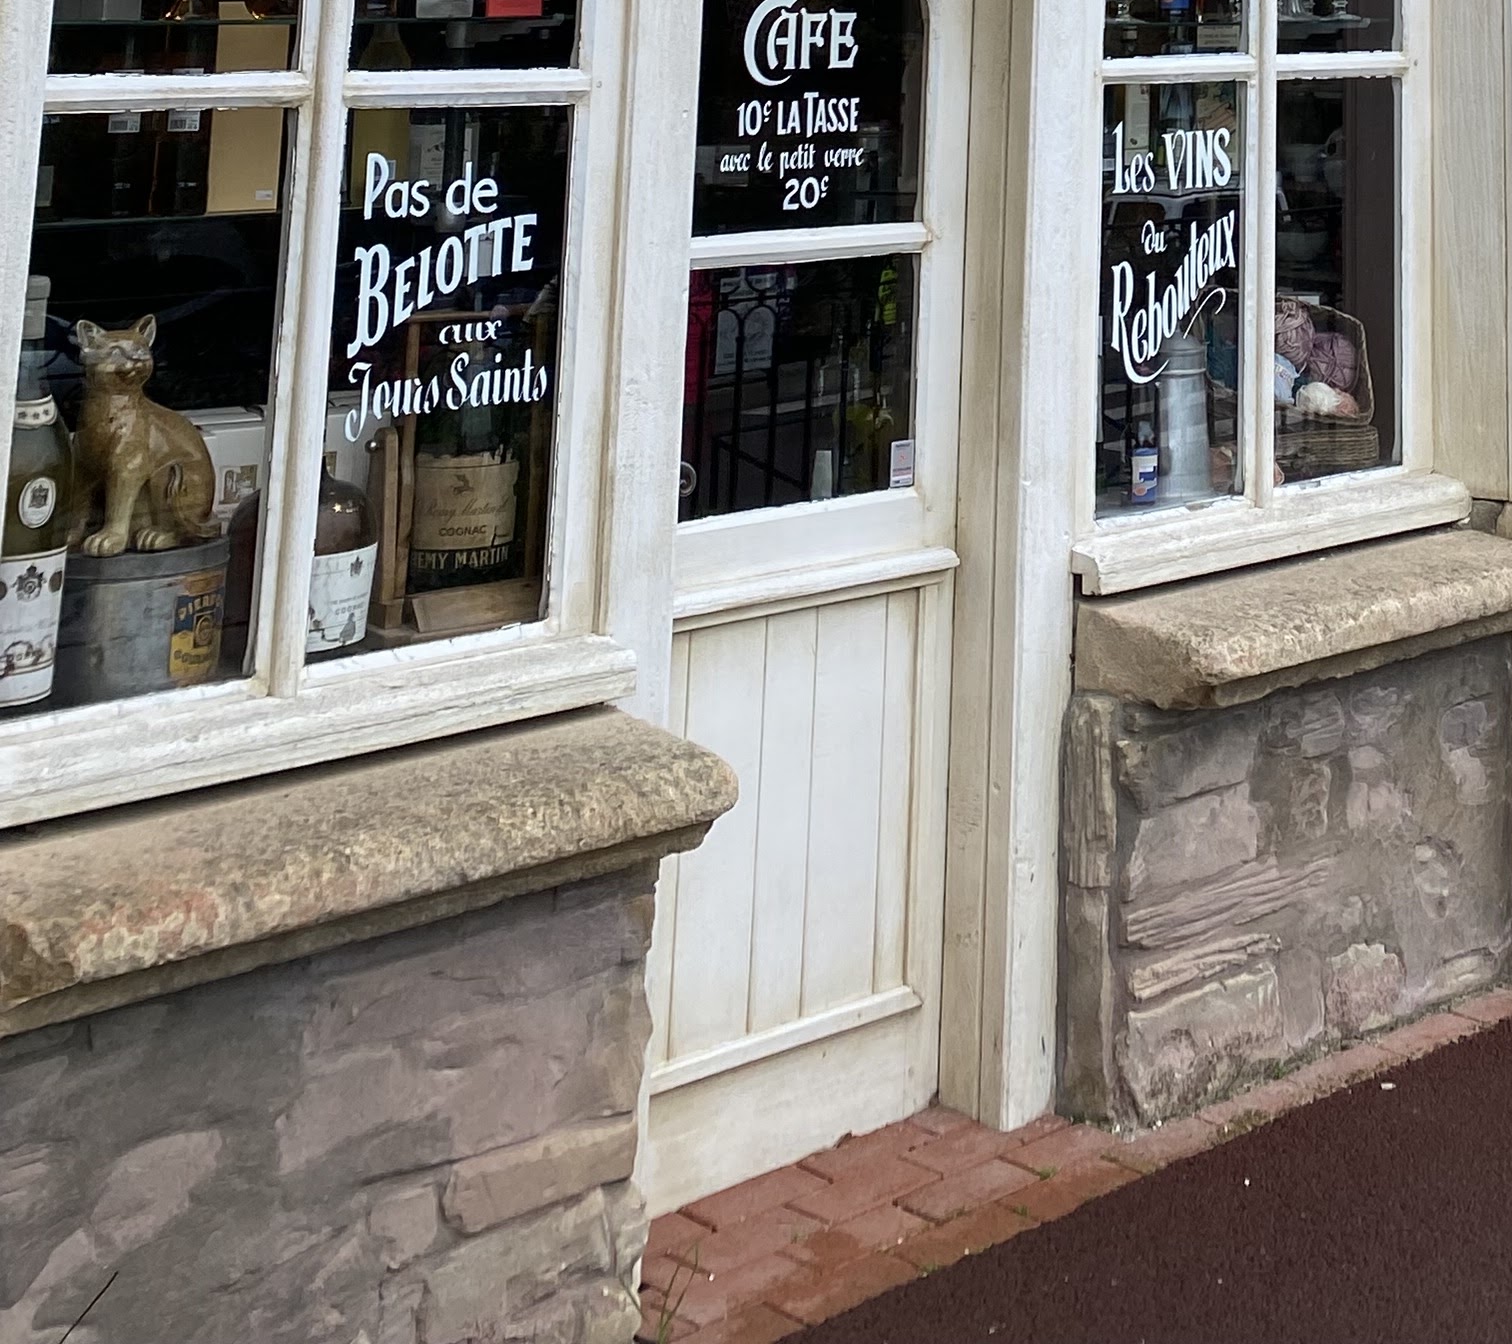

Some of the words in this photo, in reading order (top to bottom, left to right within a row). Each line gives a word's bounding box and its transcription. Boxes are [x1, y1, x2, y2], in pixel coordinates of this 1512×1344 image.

[776, 99, 801, 136] LA
[803, 91, 860, 138] TASSE
[720, 150, 751, 173] avec
[755, 141, 774, 172] le
[779, 144, 817, 179] petit
[824, 144, 866, 169] verre
[1112, 121, 1155, 195] Les
[1161, 126, 1233, 192] VINS
[363, 152, 431, 221] Pas
[445, 161, 499, 215] de
[1142, 220, 1168, 255] du
[346, 213, 538, 360] BELOTTE
[1110, 210, 1237, 385] Rebouteux
[438, 319, 503, 346] aux
[446, 348, 548, 411] Saints
[438, 525, 488, 537] COGNAC
[454, 545, 510, 570] MARTIN
